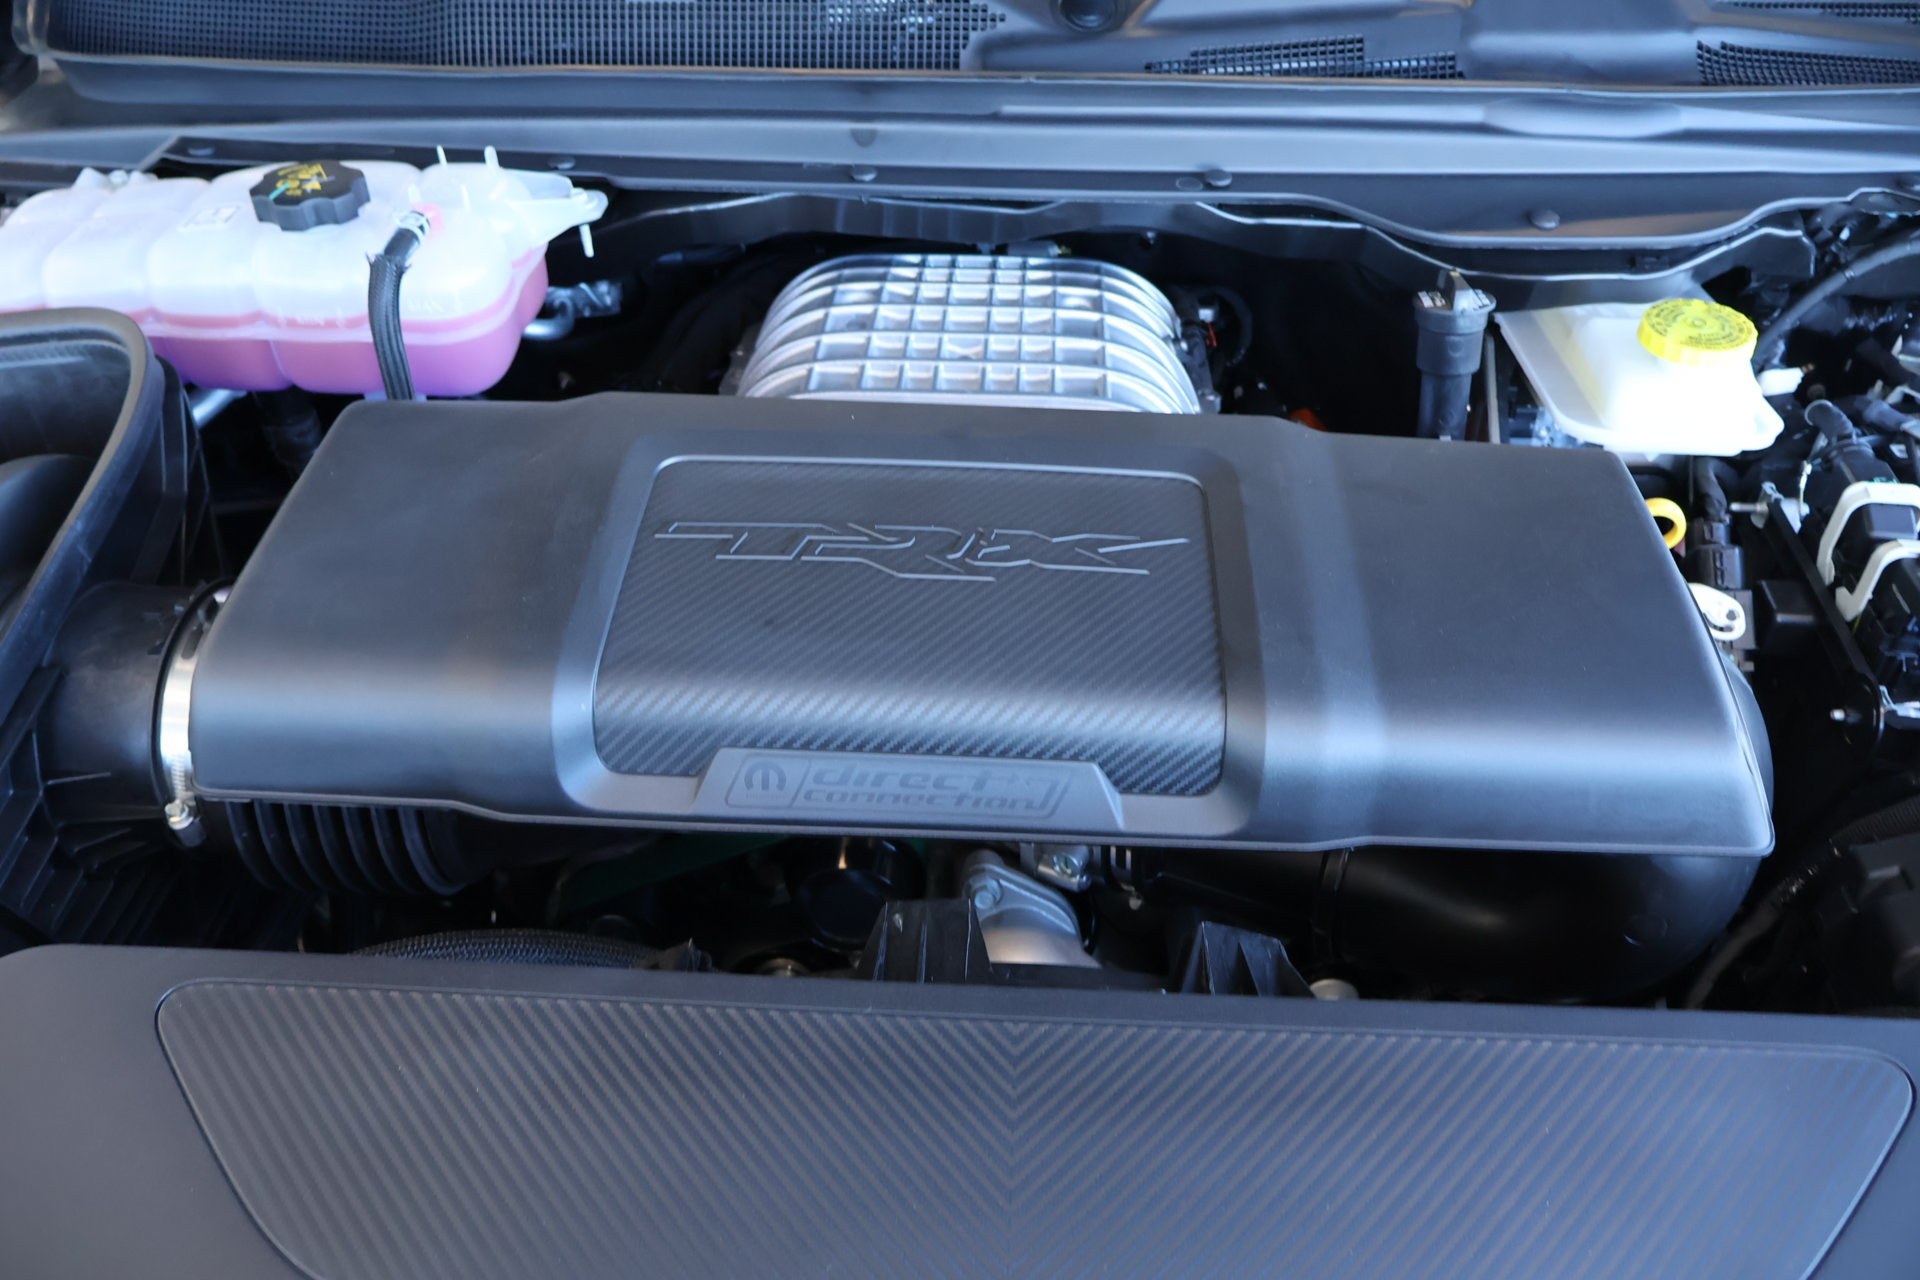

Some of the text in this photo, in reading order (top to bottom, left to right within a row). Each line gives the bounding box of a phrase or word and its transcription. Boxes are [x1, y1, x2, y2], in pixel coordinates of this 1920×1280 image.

[653, 520, 1191, 582] TRX
[812, 762, 996, 792] direct
[803, 787, 1056, 811] connection
